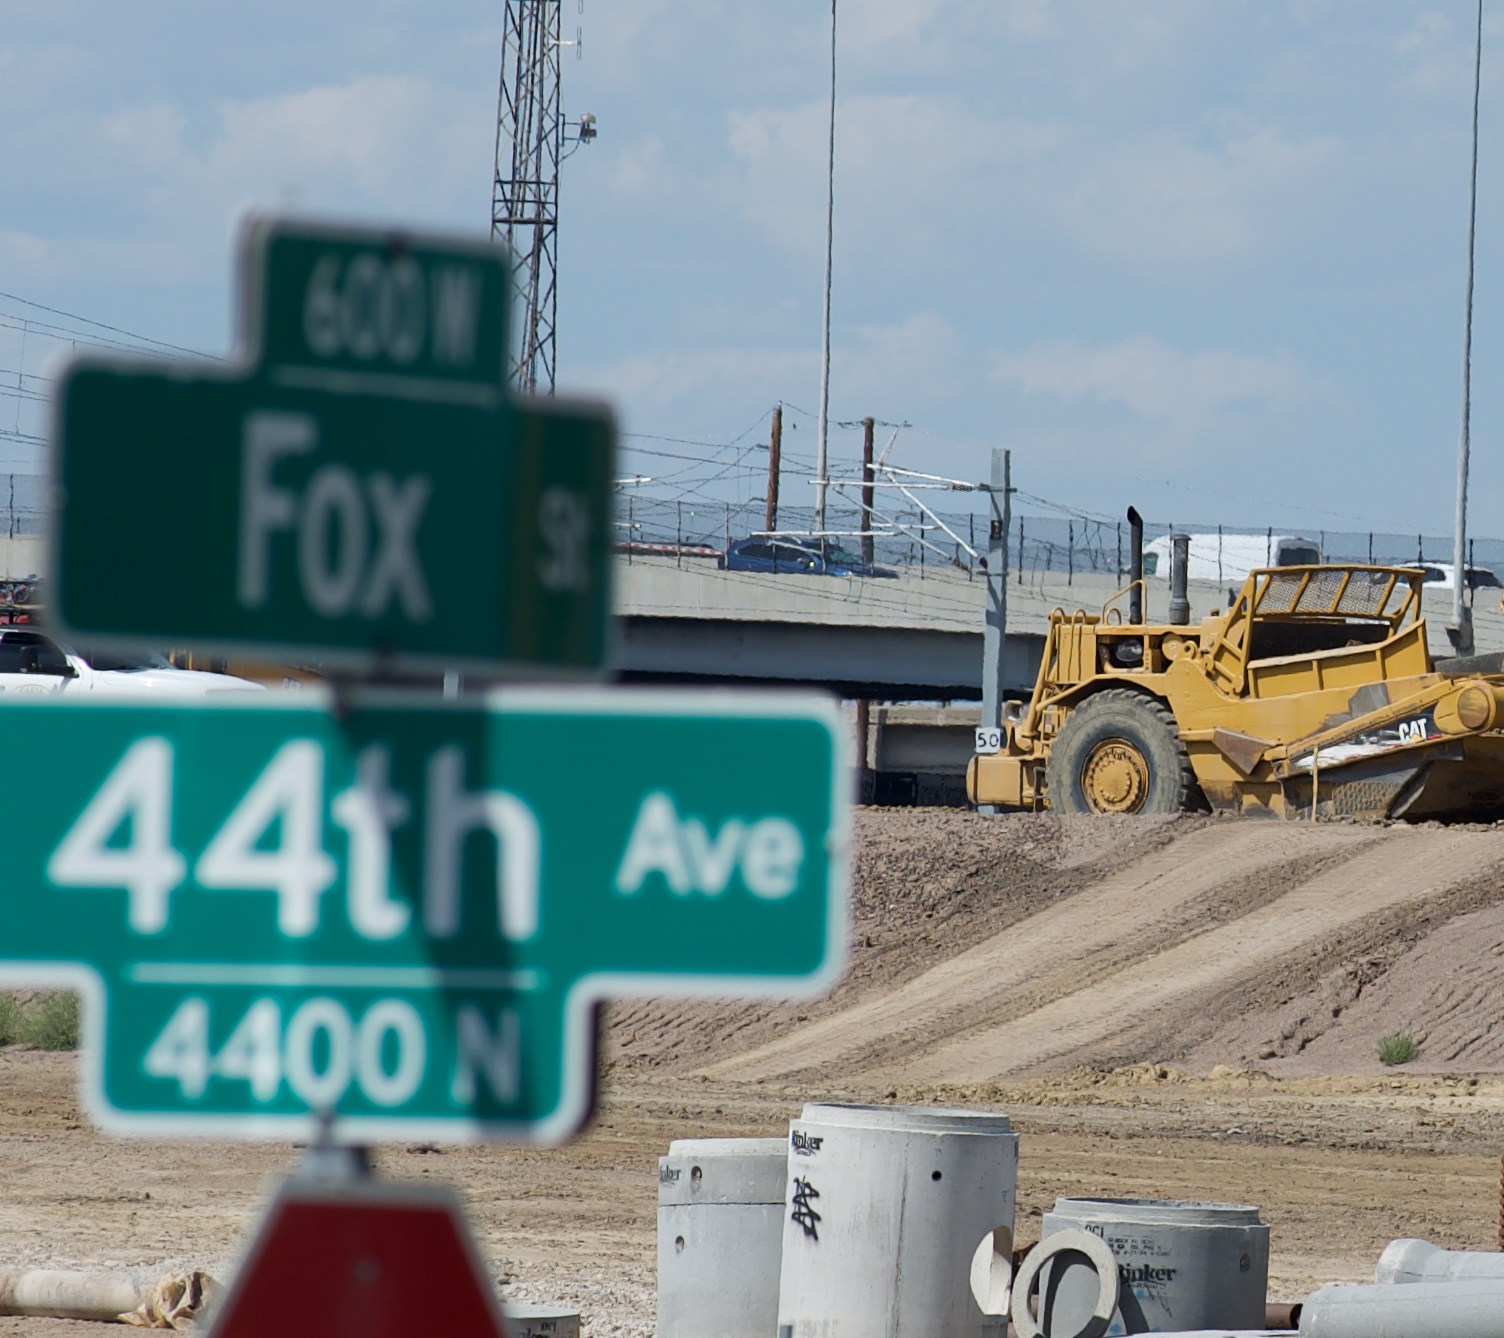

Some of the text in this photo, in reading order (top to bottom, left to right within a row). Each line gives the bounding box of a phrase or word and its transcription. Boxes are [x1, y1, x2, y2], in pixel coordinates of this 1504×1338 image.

[303, 253, 480, 365] 600 W
[238, 409, 432, 621] Fox
[978, 732, 999, 747] 50
[1398, 718, 1427, 744] CAT
[47, 734, 542, 941] 44th
[615, 791, 802, 901] Ave
[142, 996, 521, 1108] 4400 N
